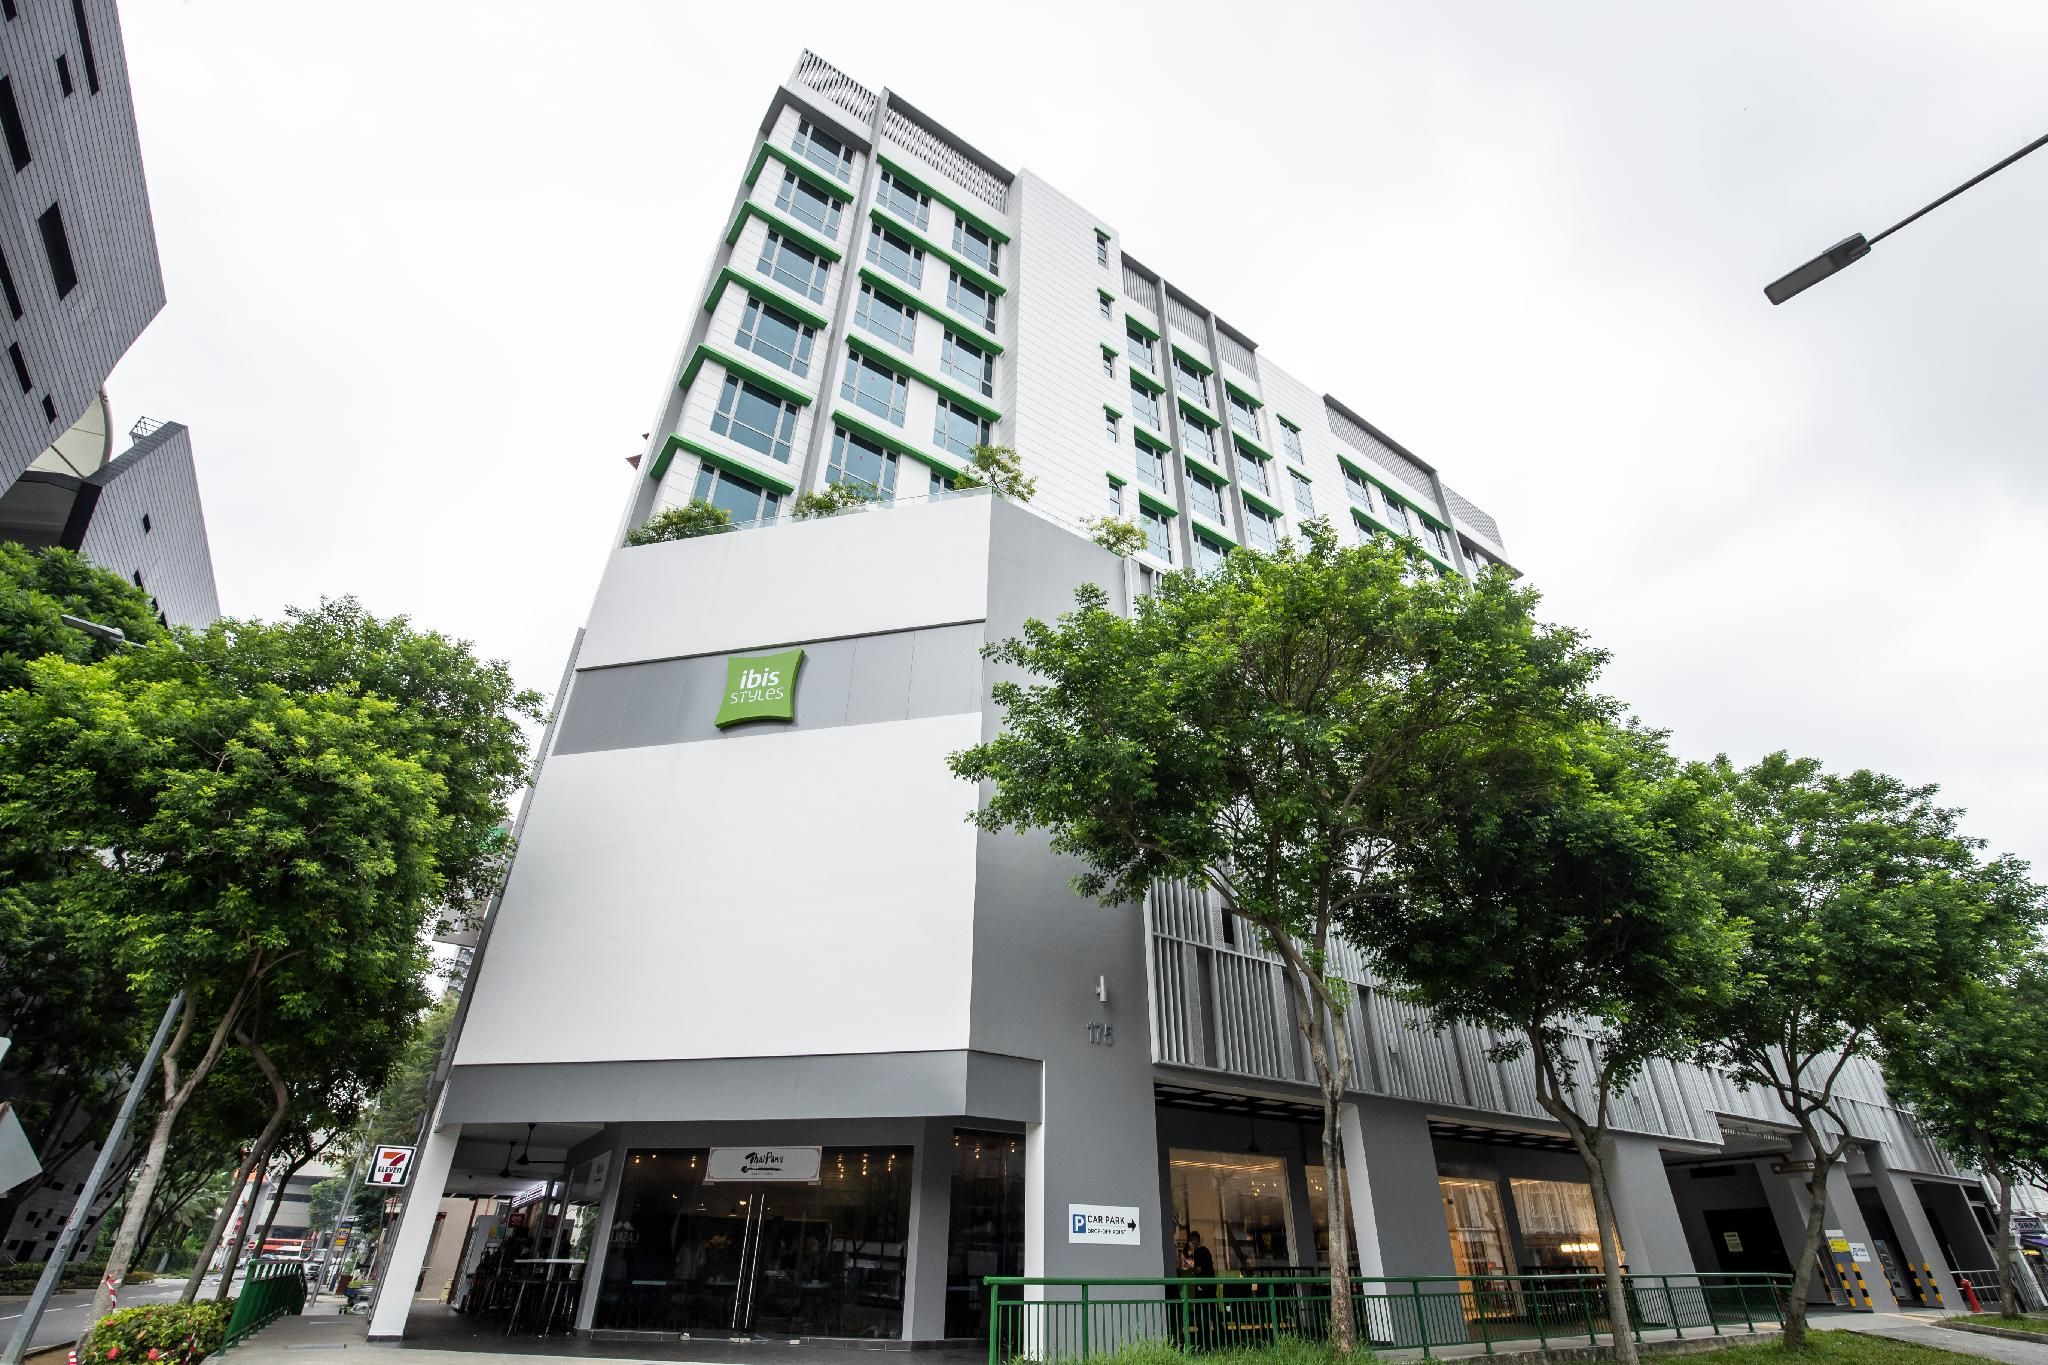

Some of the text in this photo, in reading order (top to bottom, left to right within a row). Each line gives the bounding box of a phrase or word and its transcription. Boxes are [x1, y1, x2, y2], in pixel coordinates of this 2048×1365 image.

[739, 667, 780, 690] ibis
[1087, 1215, 1125, 1225] CAR PARK
